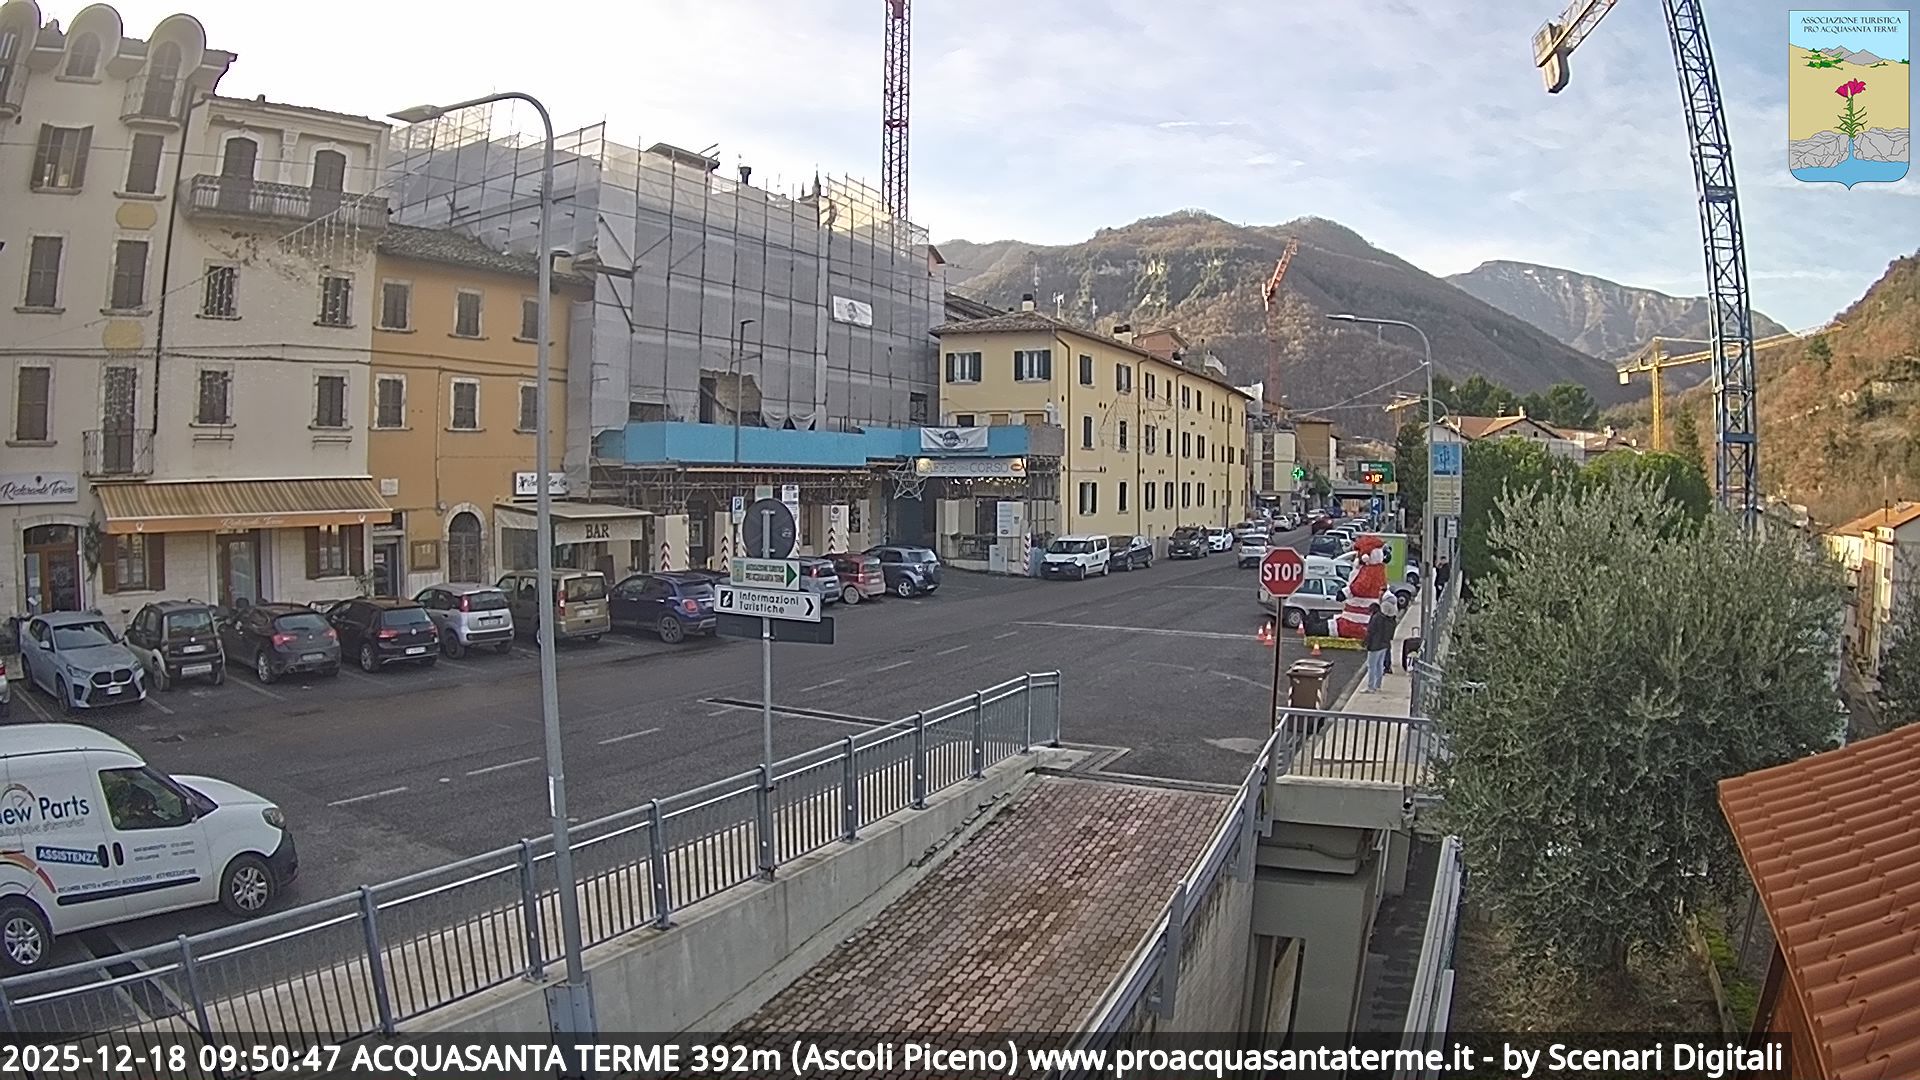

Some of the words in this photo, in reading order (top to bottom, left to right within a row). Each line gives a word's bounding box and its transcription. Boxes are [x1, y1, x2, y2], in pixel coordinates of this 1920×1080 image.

[969, 462, 1009, 473] CORSO
[585, 524, 610, 539] BAR
[1263, 563, 1302, 582] STOP
[739, 591, 799, 606] Informazioni
[739, 601, 785, 614] Turistiche
[39, 795, 90, 820] Parts
[39, 848, 99, 864] ASSISTENZA
